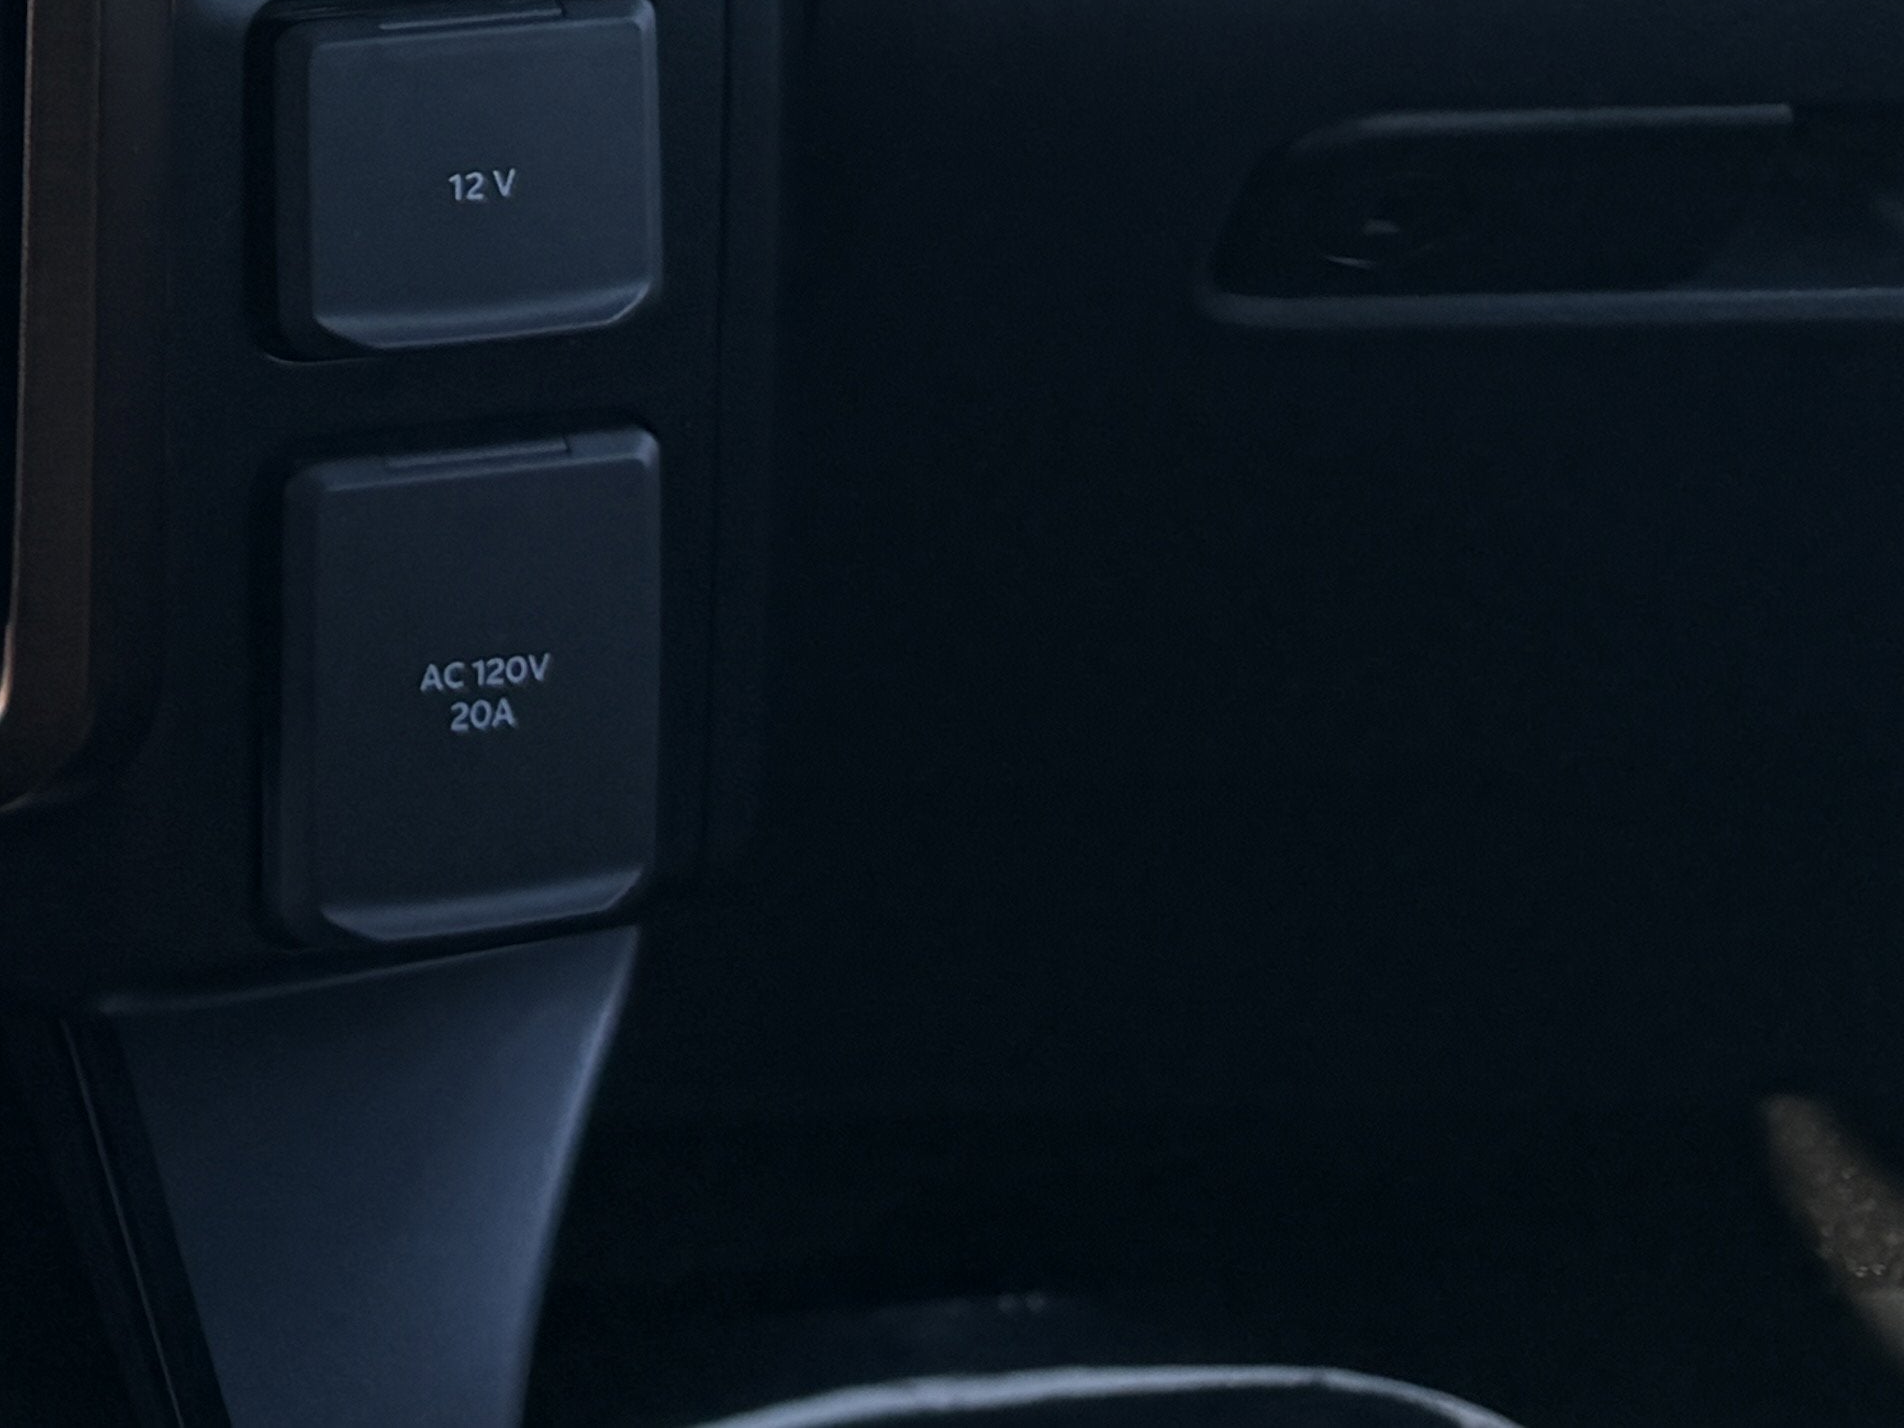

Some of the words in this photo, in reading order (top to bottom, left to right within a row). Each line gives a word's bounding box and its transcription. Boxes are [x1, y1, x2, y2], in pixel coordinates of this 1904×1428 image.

[448, 171, 485, 201] 12
[492, 168, 516, 197] V
[420, 661, 465, 691] AC
[472, 653, 551, 686] 120V
[450, 698, 516, 732] 20A
